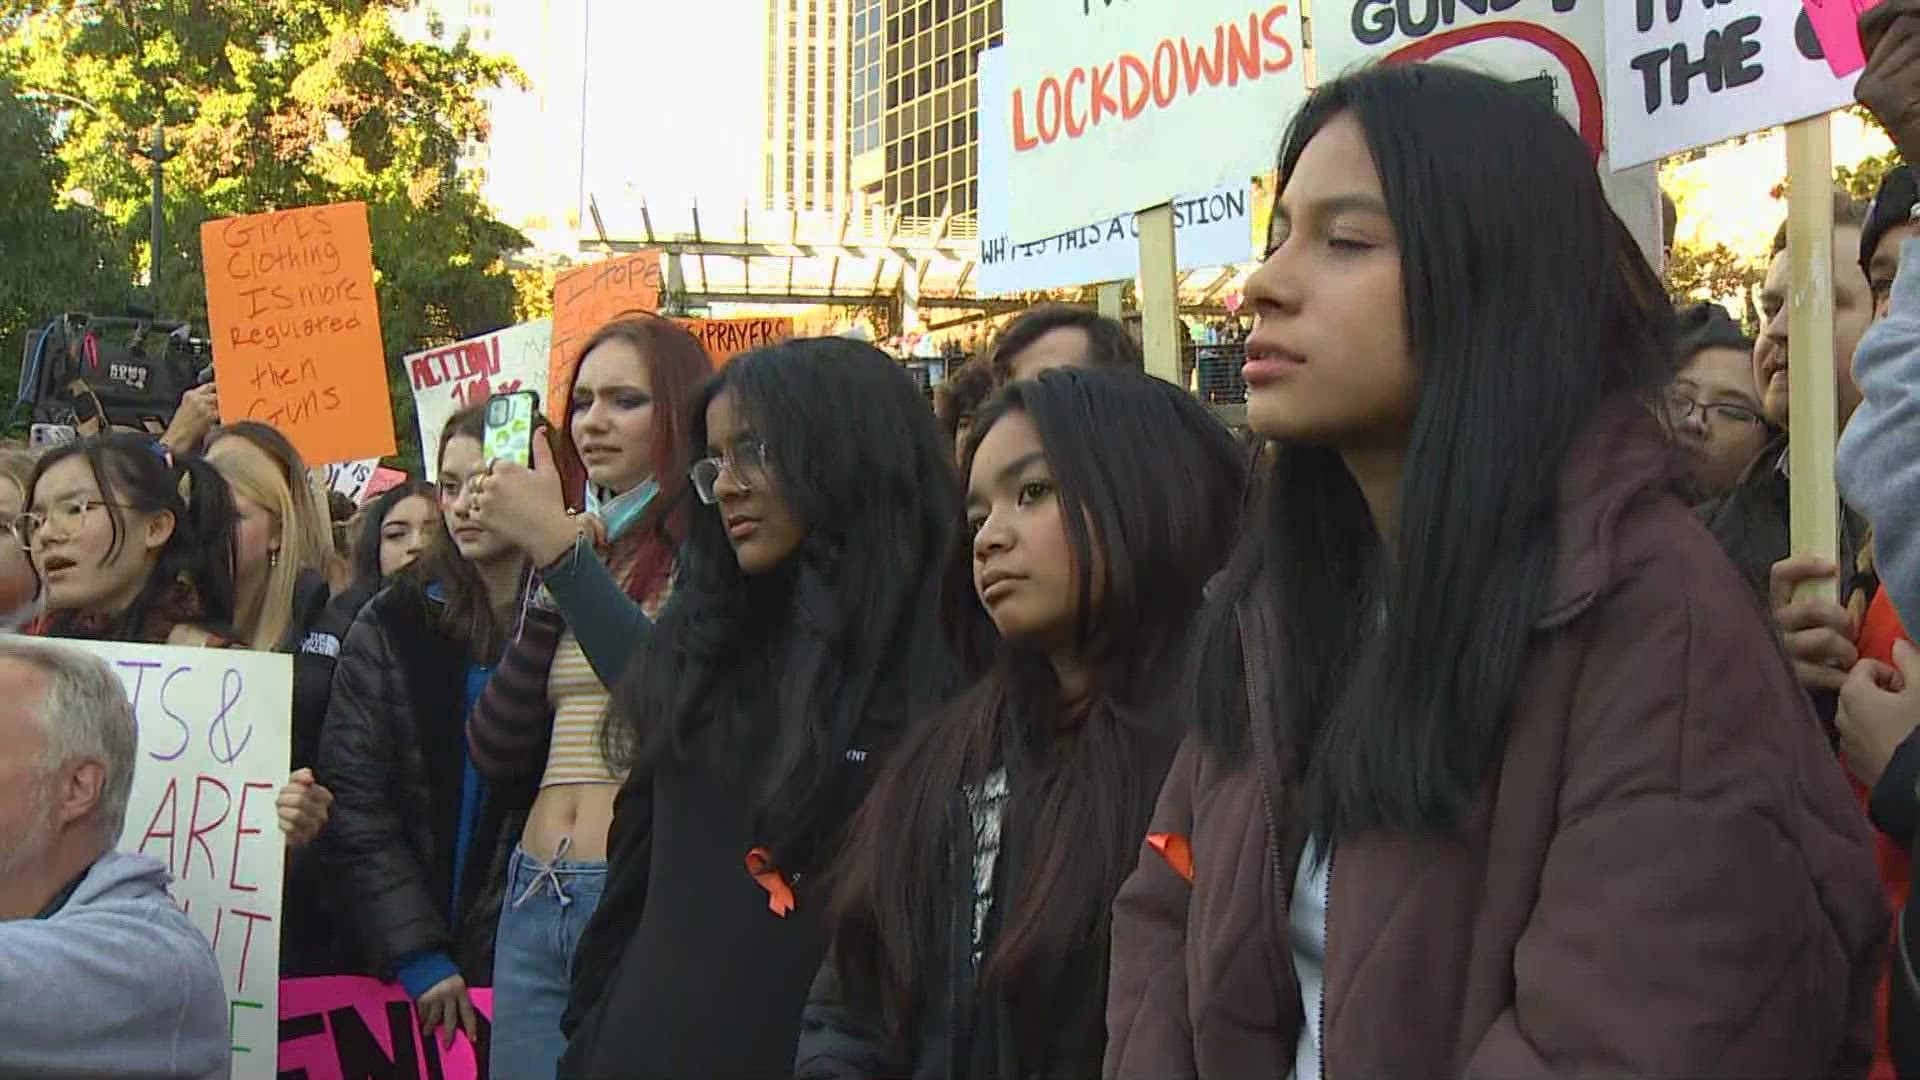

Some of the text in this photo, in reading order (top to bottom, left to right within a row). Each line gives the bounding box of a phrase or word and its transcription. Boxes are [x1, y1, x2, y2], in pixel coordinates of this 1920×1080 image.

[1012, 5, 1294, 152] LOCKDOWNS
[1630, 15, 1764, 114] THE
[1107, 217, 1125, 242] A
[227, 242, 340, 280] Clothing
[300, 277, 361, 309] more
[230, 311, 361, 351] Regulated
[250, 358, 318, 392] then
[411, 335, 501, 391] ACTION
[209, 668, 252, 768] &
[137, 776, 273, 892] ARE
